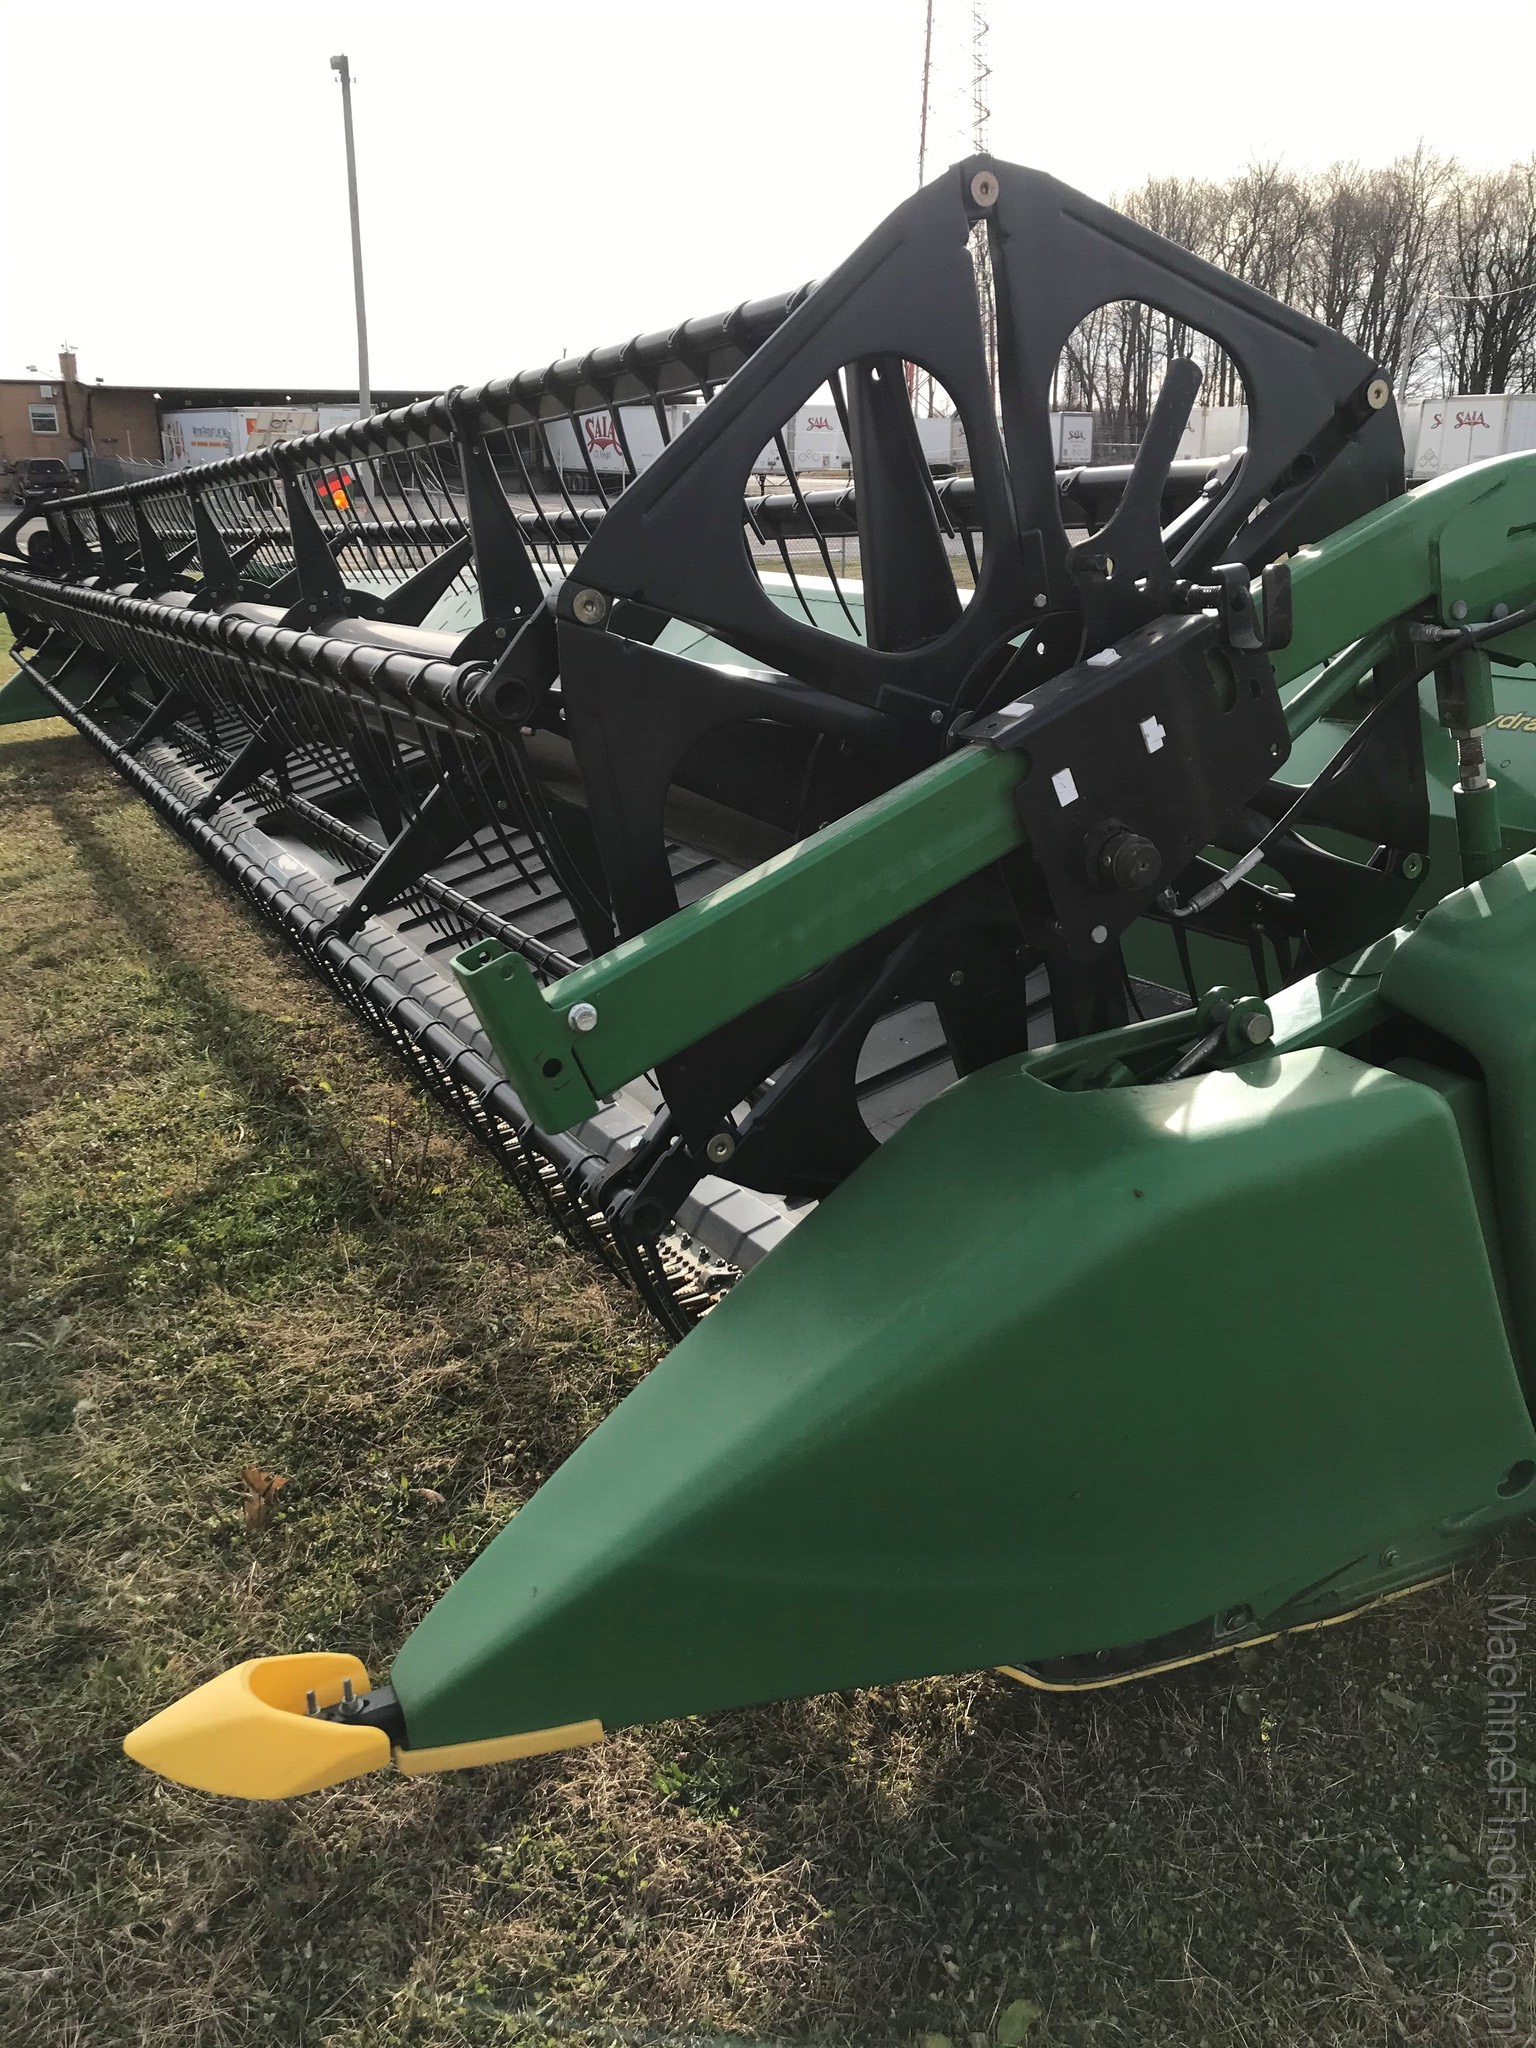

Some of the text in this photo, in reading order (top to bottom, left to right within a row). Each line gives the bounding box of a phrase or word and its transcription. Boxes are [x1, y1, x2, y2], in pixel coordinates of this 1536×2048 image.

[806, 416, 833, 431] SAIA
[1454, 410, 1490, 429] SAIA
[585, 416, 622, 456] SAIA
[1067, 430, 1086, 441] SAIA
